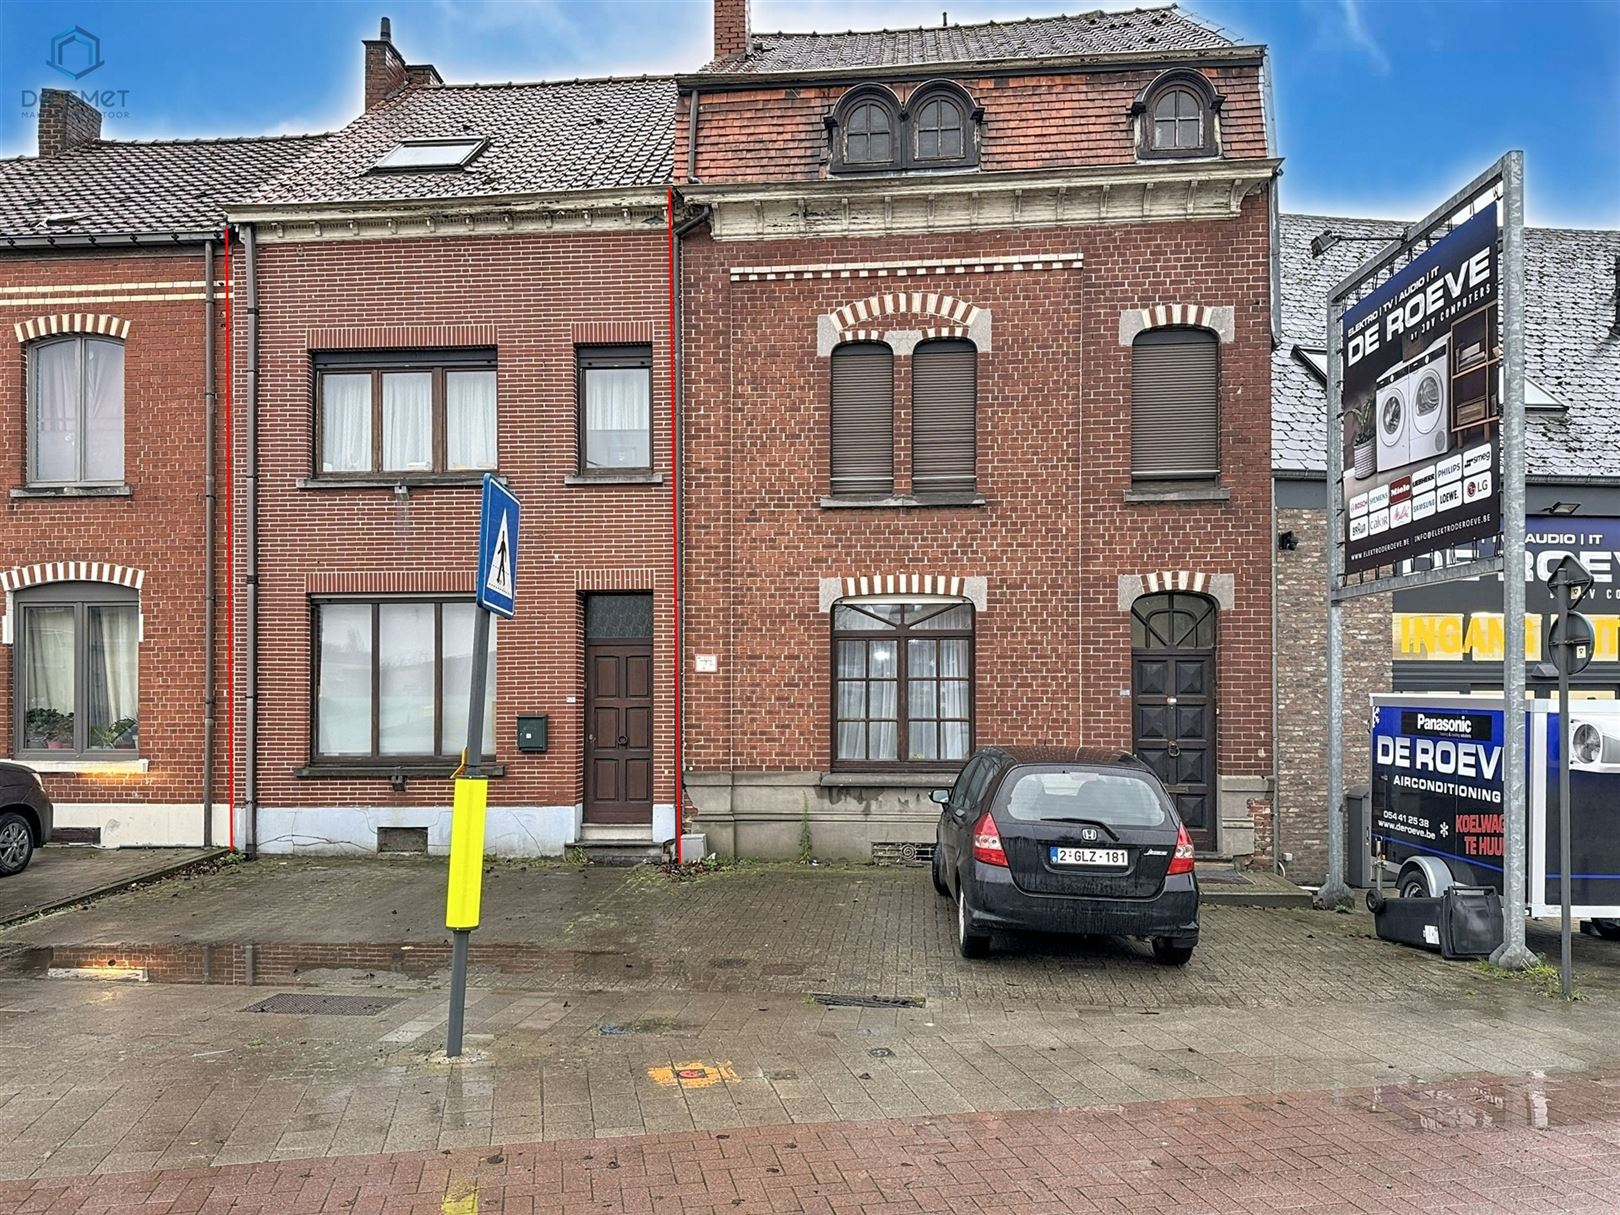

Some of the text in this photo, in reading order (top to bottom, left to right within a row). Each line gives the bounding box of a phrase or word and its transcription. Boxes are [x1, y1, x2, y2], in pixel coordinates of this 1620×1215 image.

[1347, 265, 1440, 338] ELEKTRO TV AUDIO IT
[1347, 246, 1490, 368] DE ROEVE
[1440, 283, 1491, 322] COMPUTERS
[1473, 451, 1491, 464] smeg
[1438, 462, 1461, 478] PHILIPS
[1390, 484, 1411, 497] Miele
[1477, 479, 1488, 493] LG
[1413, 499, 1435, 513] SAMSUNG
[1525, 533, 1604, 545] AUDIO IT
[1417, 713, 1472, 734] Panasonic
[1377, 735, 1505, 782] DE ROEV
[1393, 774, 1501, 804] AIRCONDITIONING
[1378, 820, 1436, 840] www.deroeve.be
[1408, 815, 1418, 825] 25
[1464, 836, 1504, 856] TE HUU
